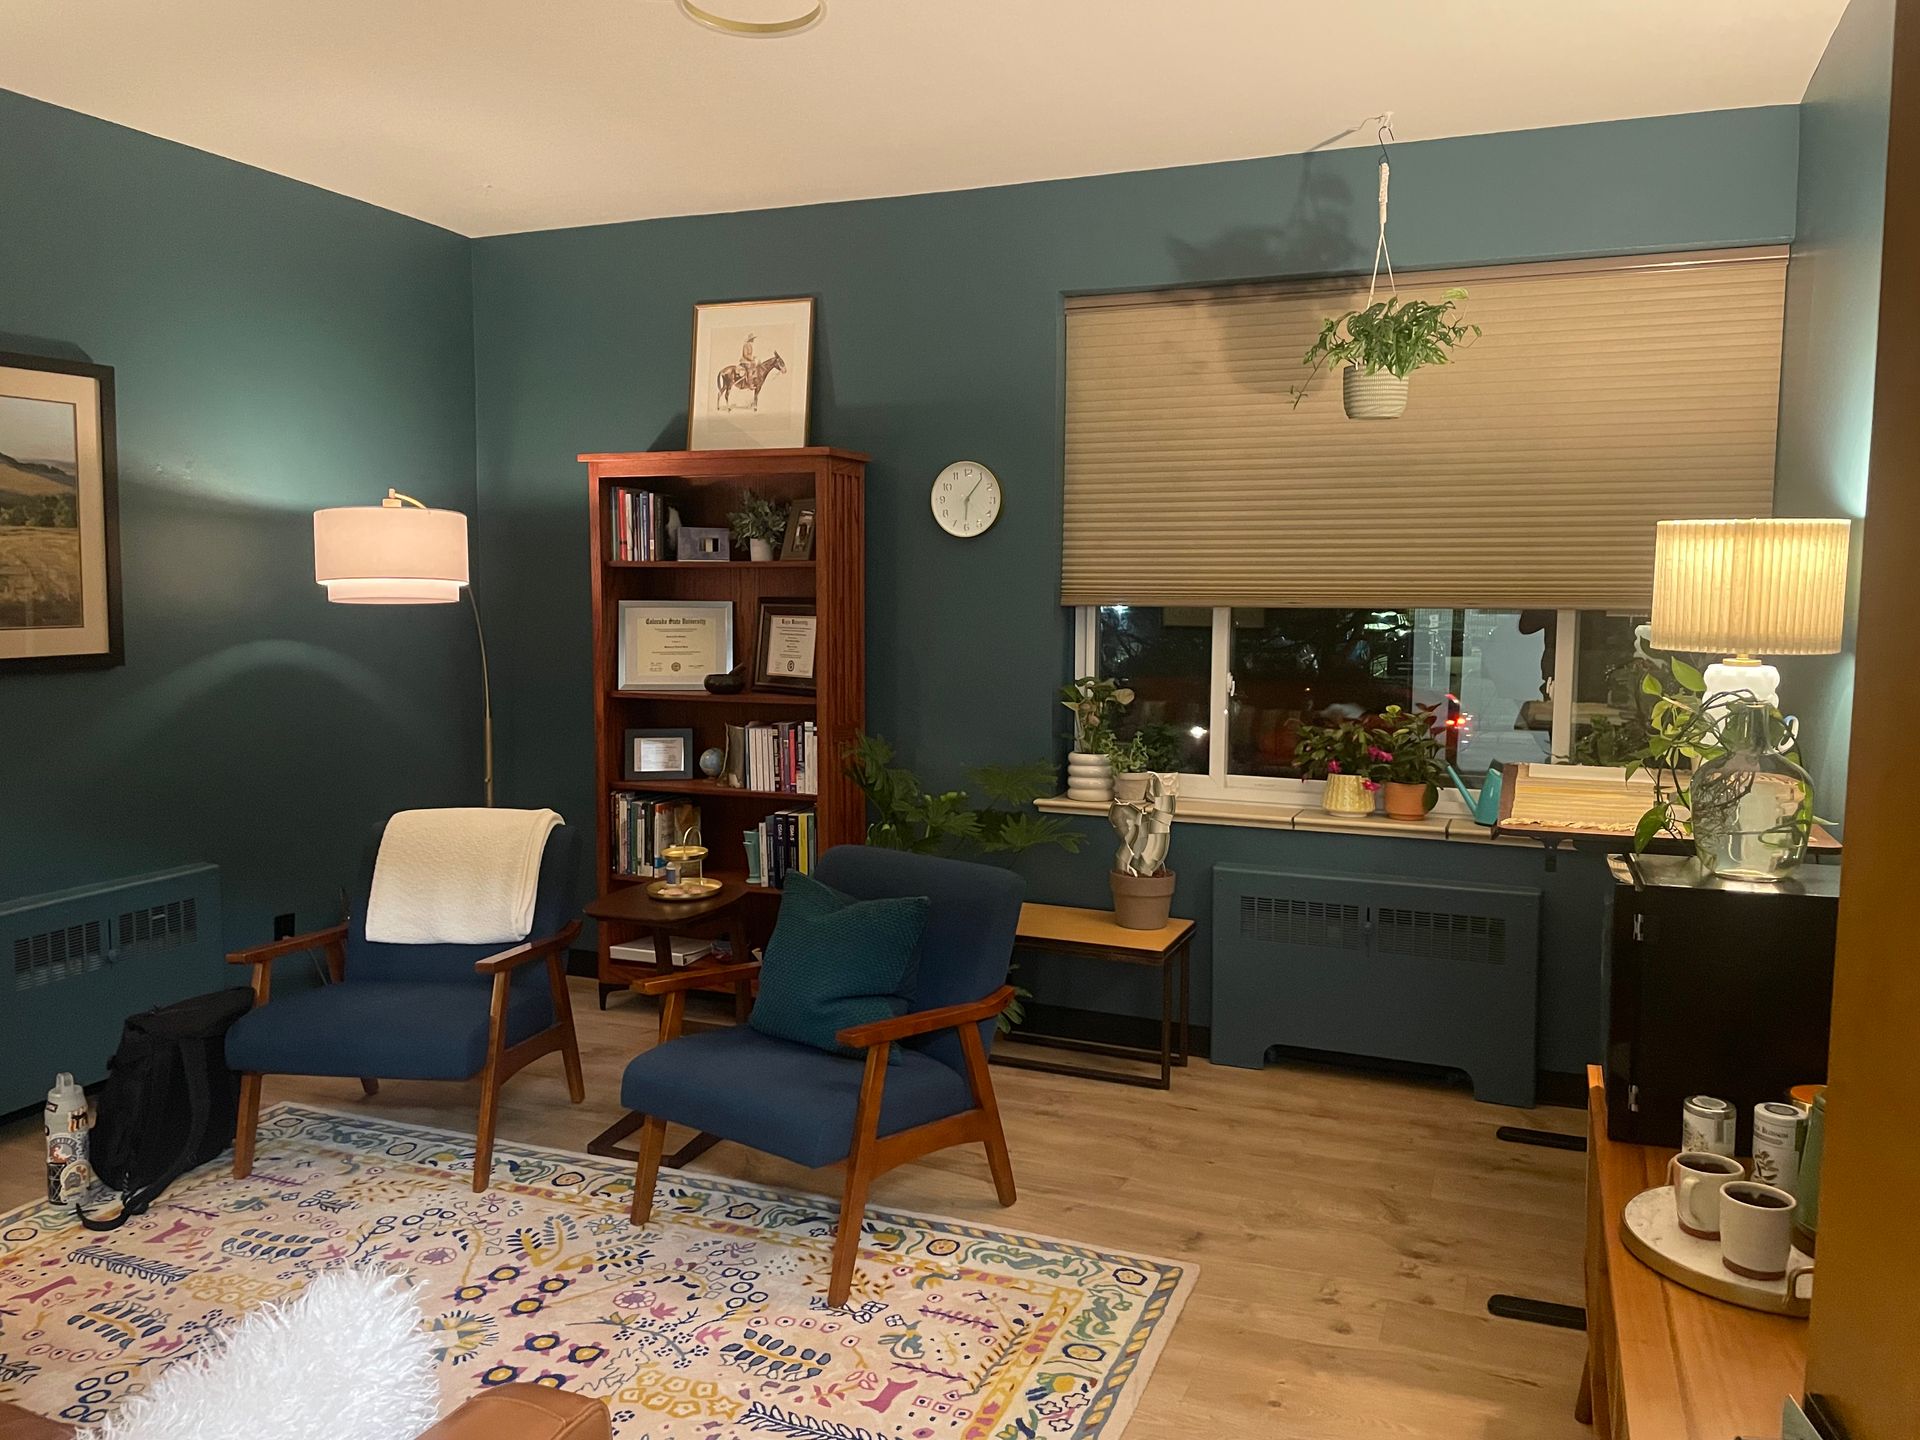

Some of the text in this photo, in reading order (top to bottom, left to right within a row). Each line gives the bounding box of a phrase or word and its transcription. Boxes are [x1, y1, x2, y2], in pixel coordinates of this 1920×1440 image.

[953, 472, 959, 480] 11
[964, 468, 972, 477] 12
[943, 483, 952, 491] 10
[986, 482, 992, 491] 2
[940, 496, 945, 504] 9
[942, 509, 948, 518] 8
[682, 618, 706, 626] University
